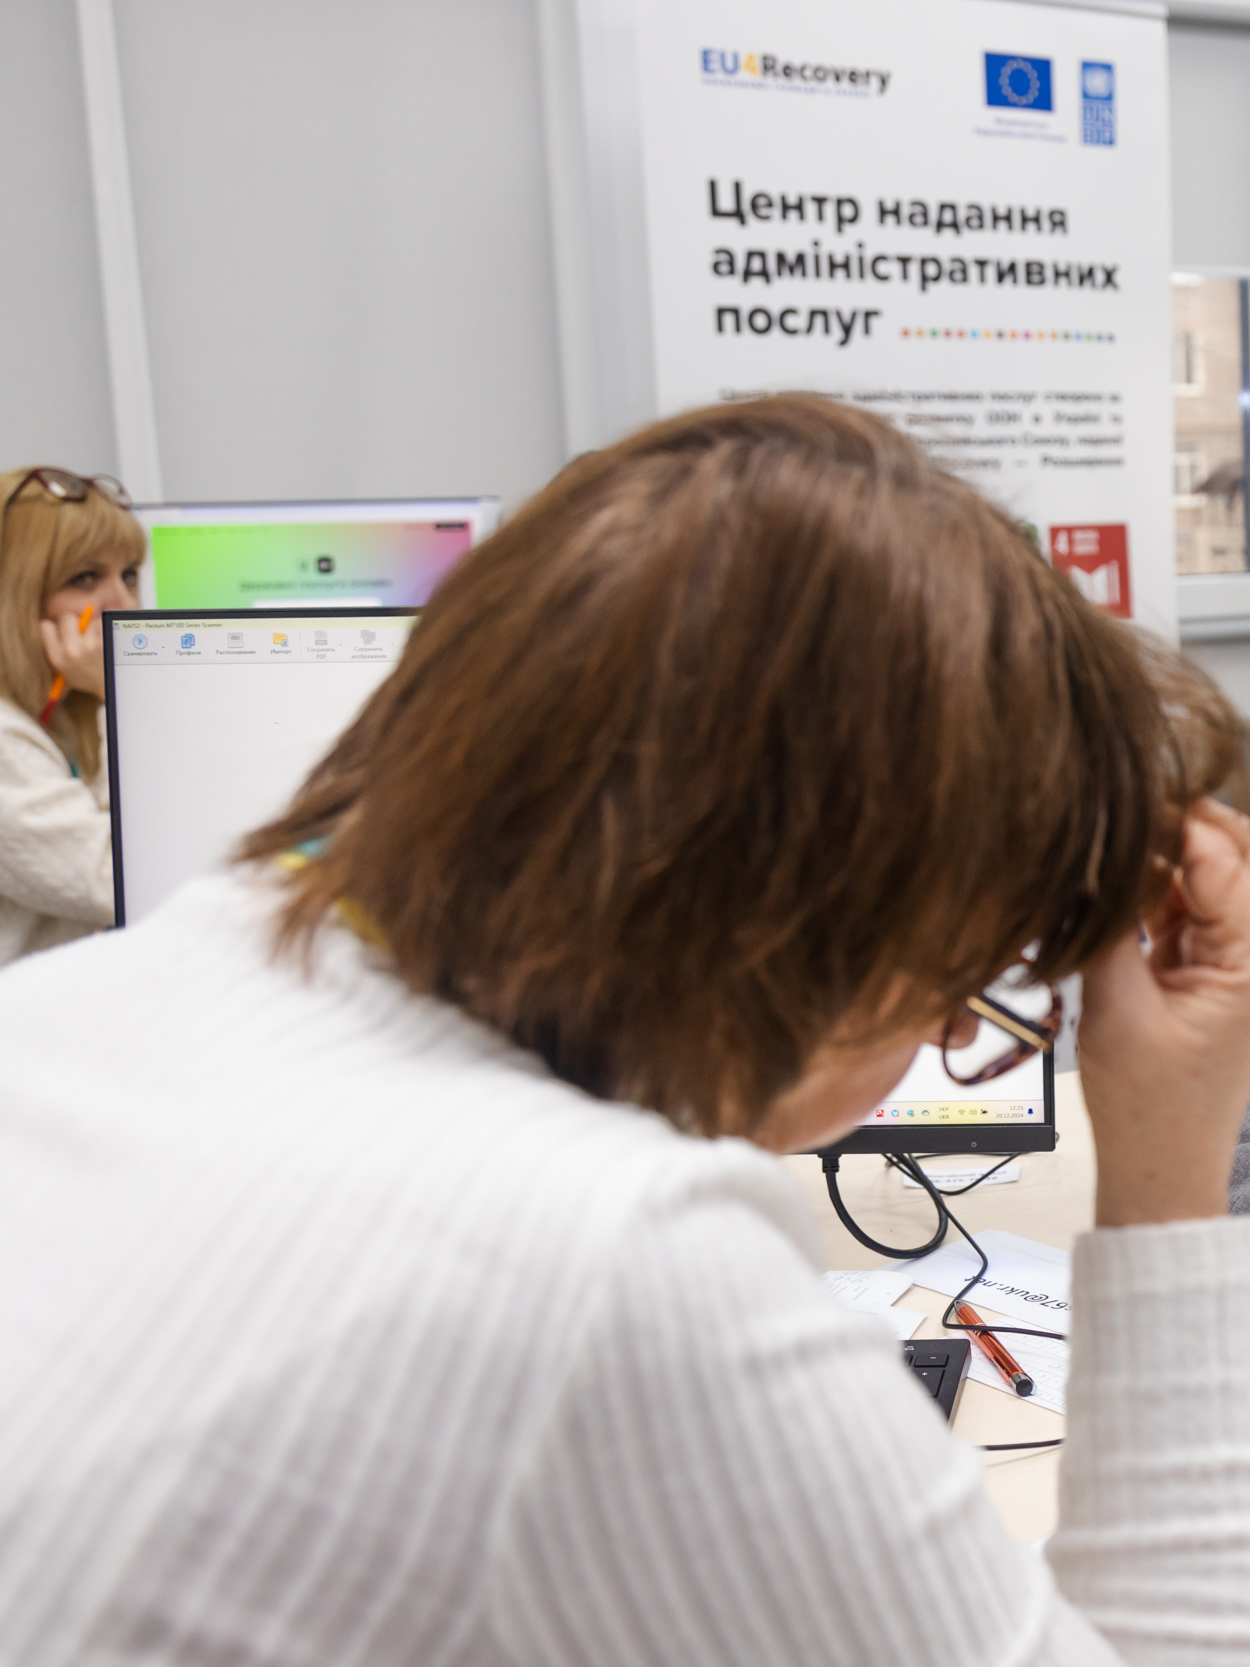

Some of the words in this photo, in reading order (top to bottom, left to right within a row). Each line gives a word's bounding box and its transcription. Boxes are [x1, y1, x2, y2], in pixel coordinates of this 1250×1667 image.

[701, 48, 891, 96] EU4Recovery
[708, 178, 860, 232] Центр
[877, 197, 1068, 236] надання
[712, 241, 1120, 292] адміністративних
[715, 304, 881, 347] послуг
